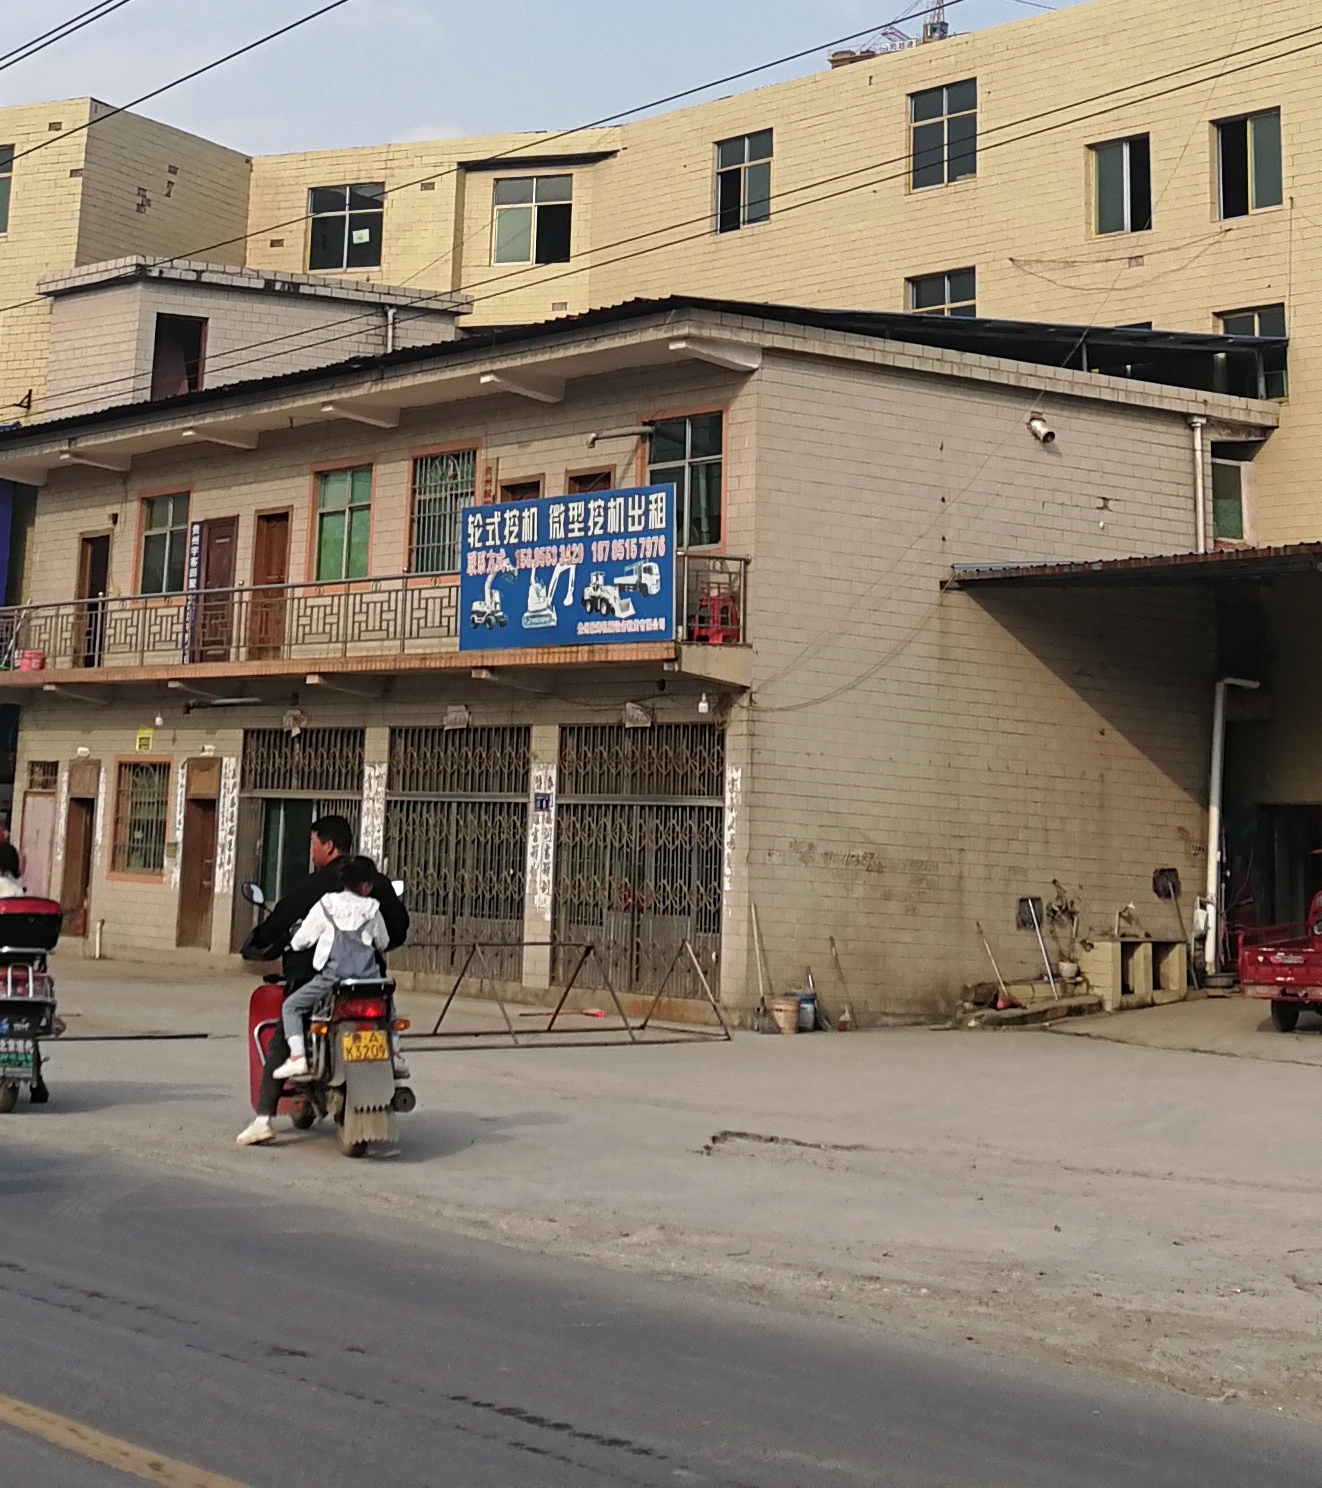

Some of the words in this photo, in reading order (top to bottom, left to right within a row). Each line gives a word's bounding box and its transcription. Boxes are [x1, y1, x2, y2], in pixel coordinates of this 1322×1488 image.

[467, 507, 539, 548] 轮式挖机
[548, 492, 667, 540] 微型挖机出租
